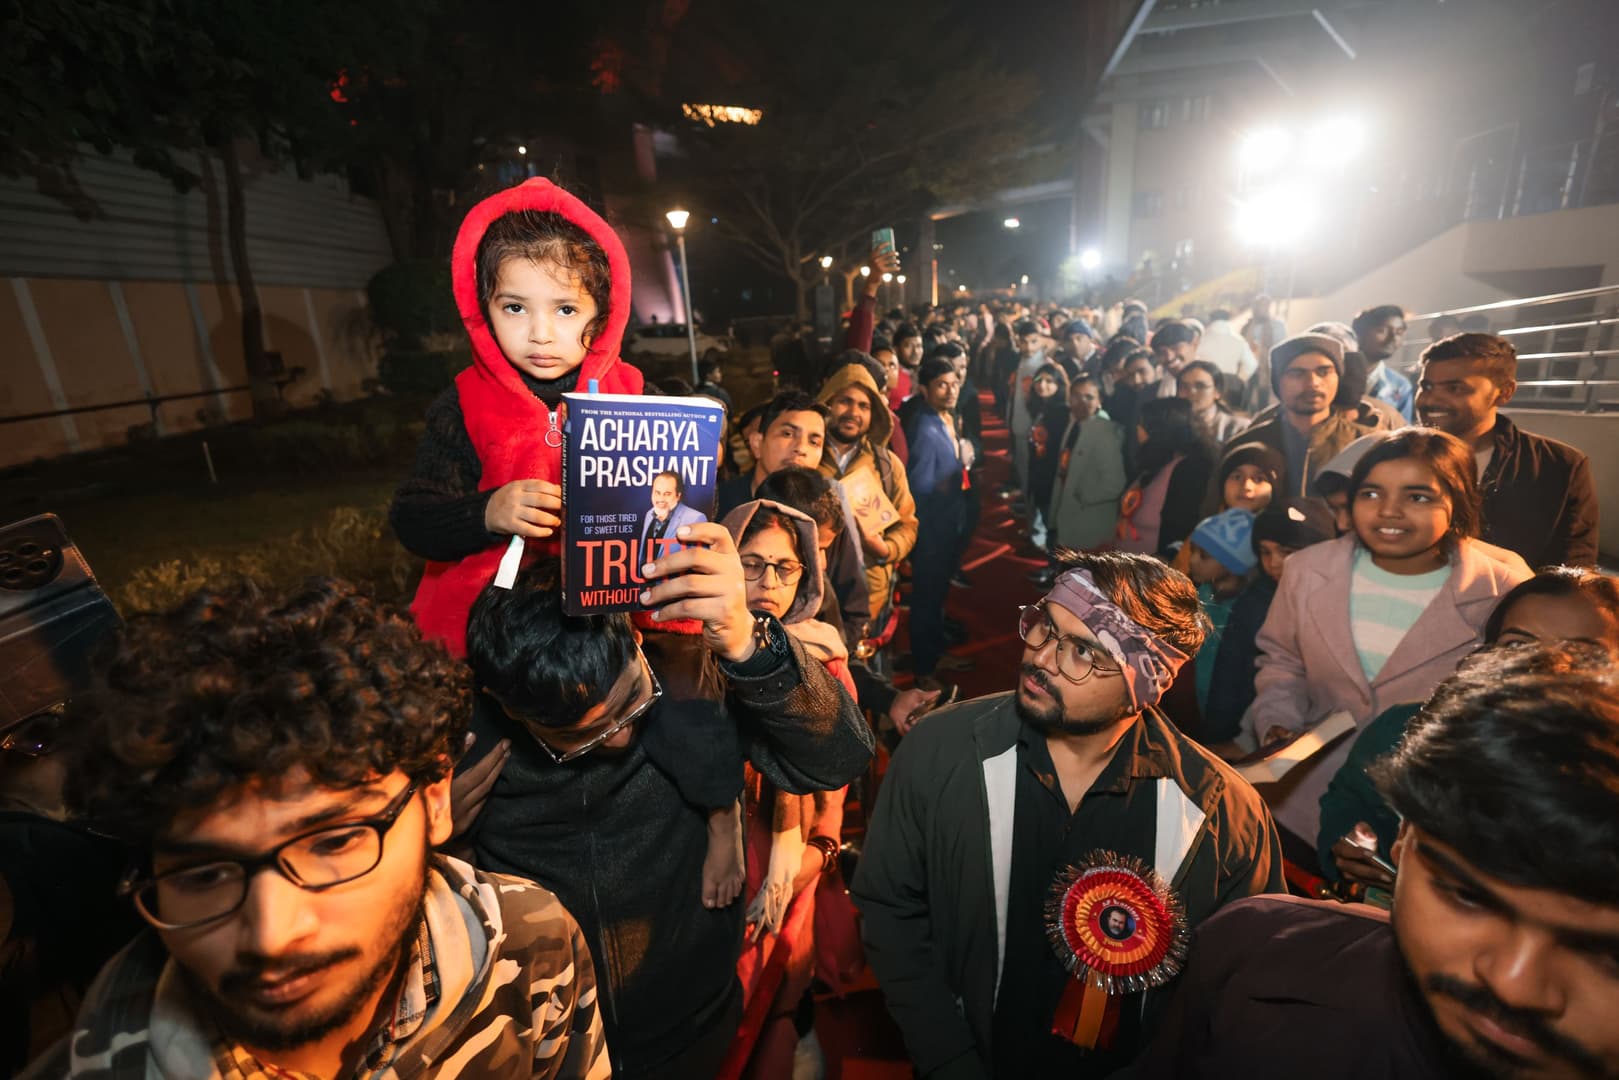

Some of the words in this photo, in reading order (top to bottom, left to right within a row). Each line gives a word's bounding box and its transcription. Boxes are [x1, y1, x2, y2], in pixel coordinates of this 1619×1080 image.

[580, 418, 699, 451] ACHARYA
[580, 515, 594, 523] FOR
[596, 514, 616, 523] THOSE
[618, 514, 637, 522] TIRED
[584, 526, 594, 535] OF
[595, 525, 617, 535] SWEET
[618, 525, 633, 533] LIES
[576, 538, 702, 587] TRUT
[580, 588, 640, 607] WITHOUT
